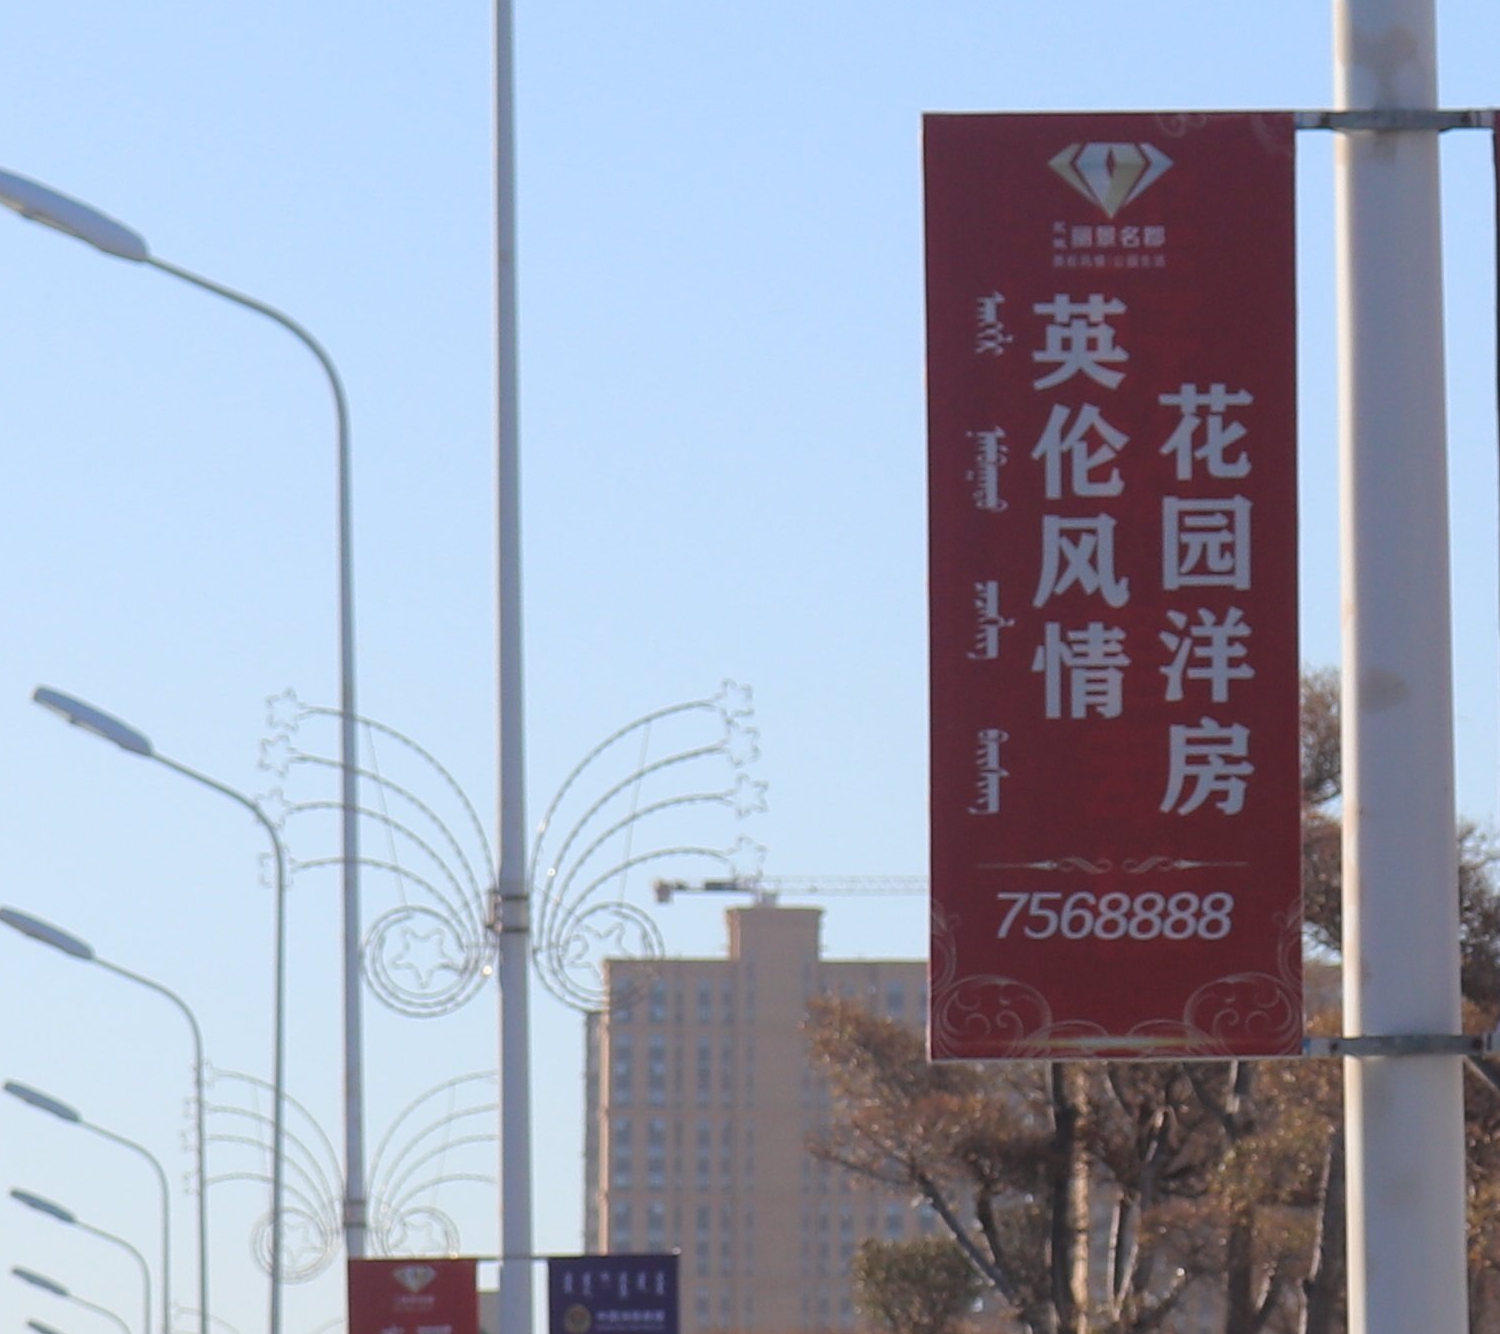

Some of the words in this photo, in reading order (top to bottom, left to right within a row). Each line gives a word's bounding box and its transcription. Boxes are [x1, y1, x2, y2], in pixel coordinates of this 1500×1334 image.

[1032, 292, 1132, 721] 英伦风情
[1158, 382, 1256, 817] 花园洋房
[995, 891, 1235, 941] 7568888
